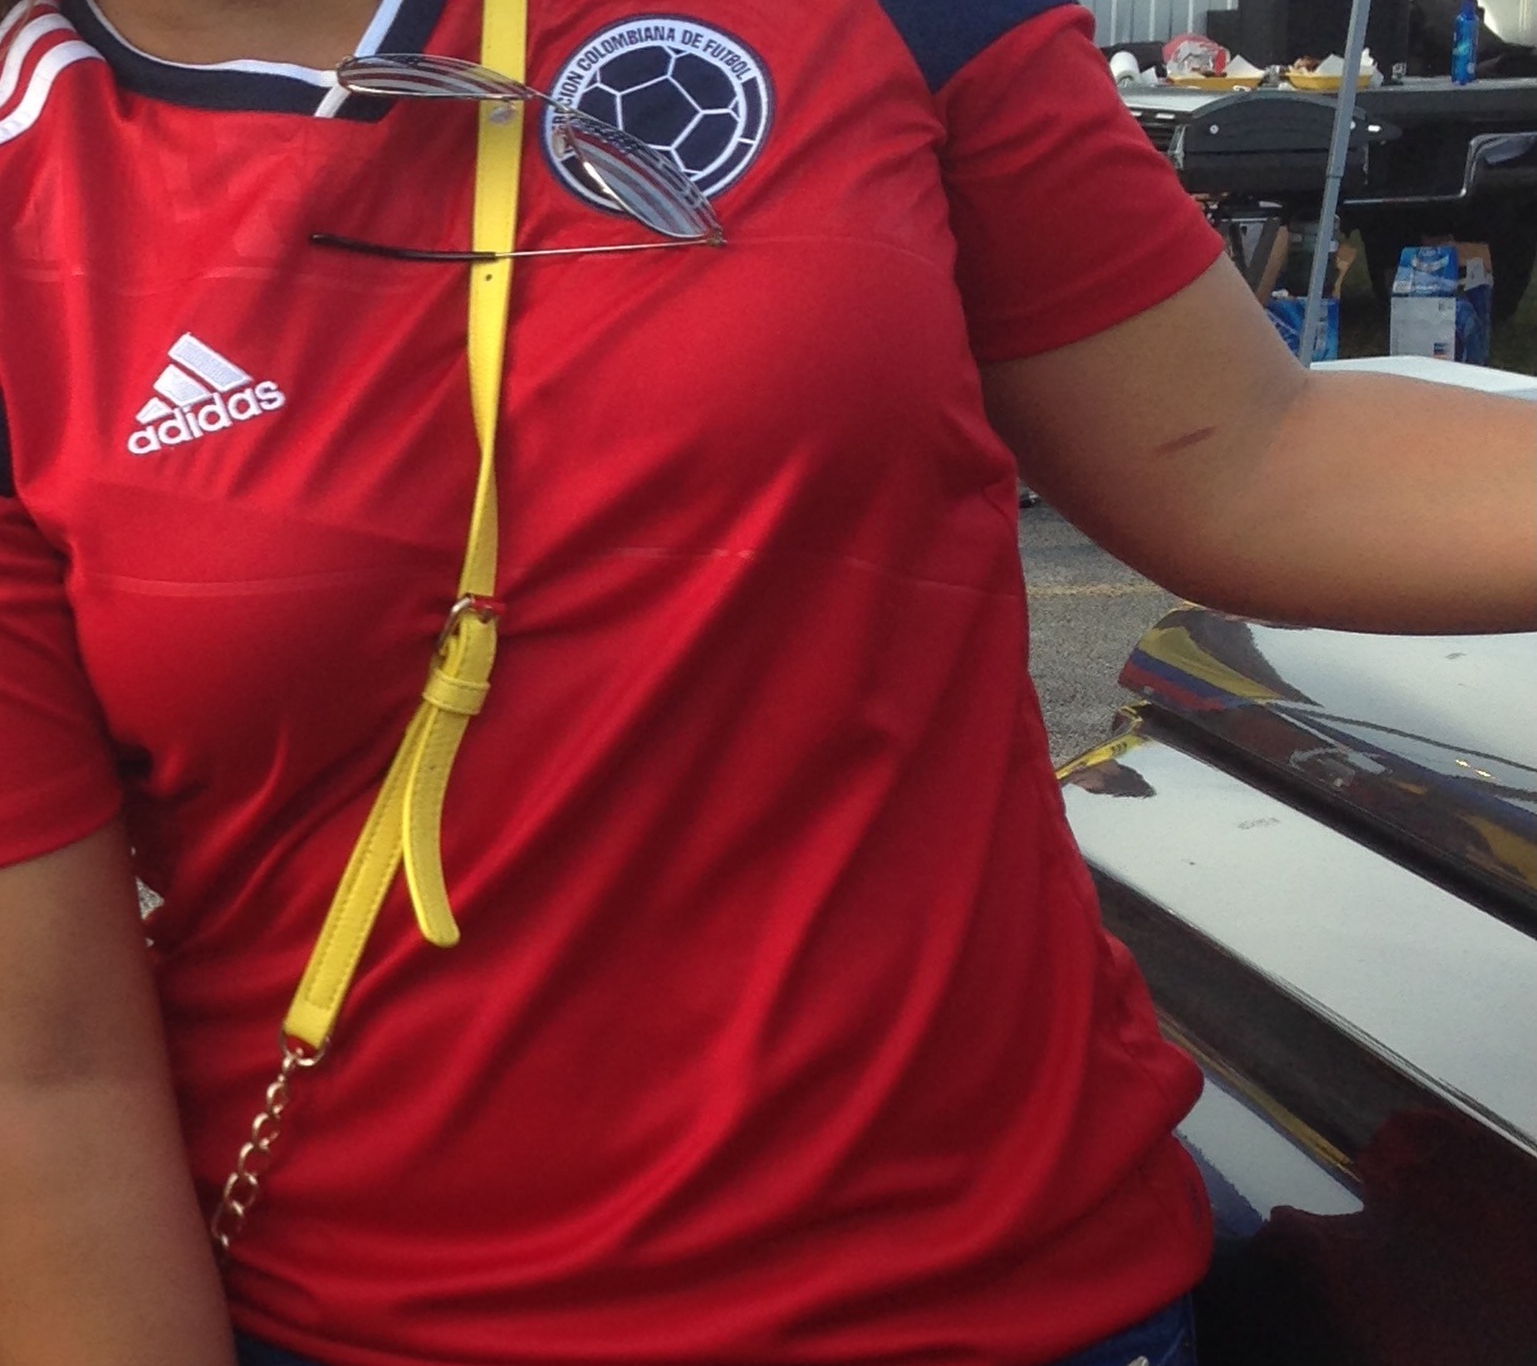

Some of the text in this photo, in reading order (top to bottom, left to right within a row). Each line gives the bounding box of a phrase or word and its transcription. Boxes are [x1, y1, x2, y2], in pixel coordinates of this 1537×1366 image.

[578, 26, 676, 71] COLOMBIANA
[681, 29, 704, 49] DE
[705, 40, 750, 82] FUTBOL
[127, 380, 286, 454] adidas
